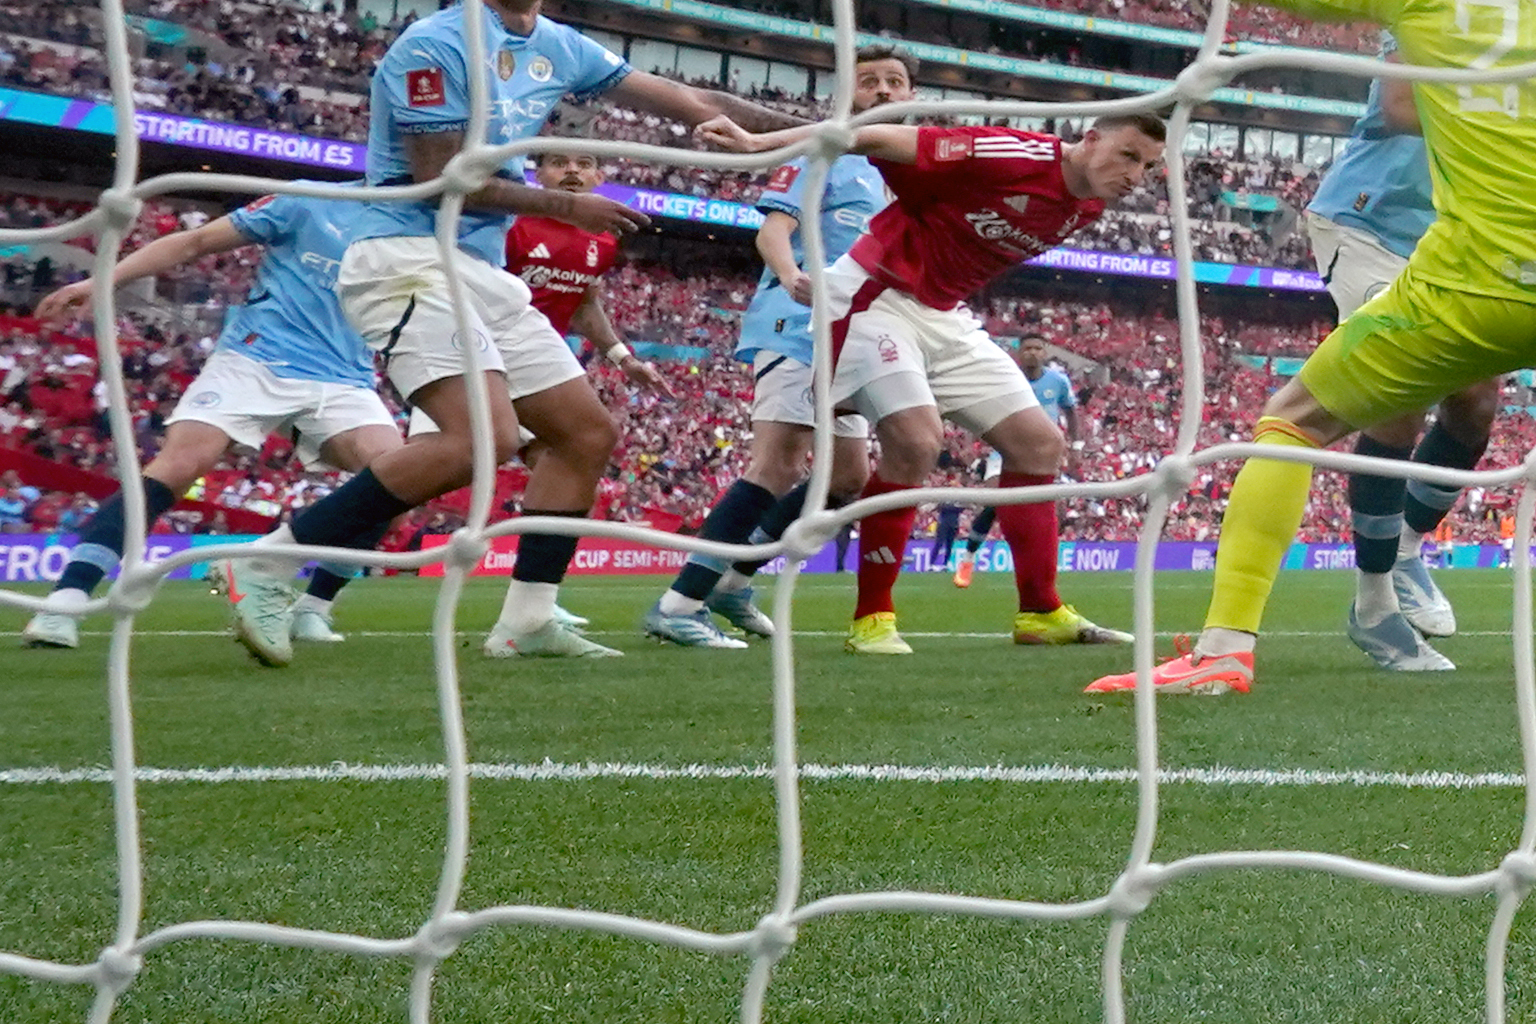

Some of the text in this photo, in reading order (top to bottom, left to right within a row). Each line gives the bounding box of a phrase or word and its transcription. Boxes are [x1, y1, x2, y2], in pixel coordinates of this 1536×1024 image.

[134, 115, 354, 166] STARTING FROM £5
[637, 191, 766, 227] TICKETS ON SA
[1101, 257, 1147, 274] FROM
[574, 549, 610, 568] CUP
[1076, 548, 1119, 570] NOW
